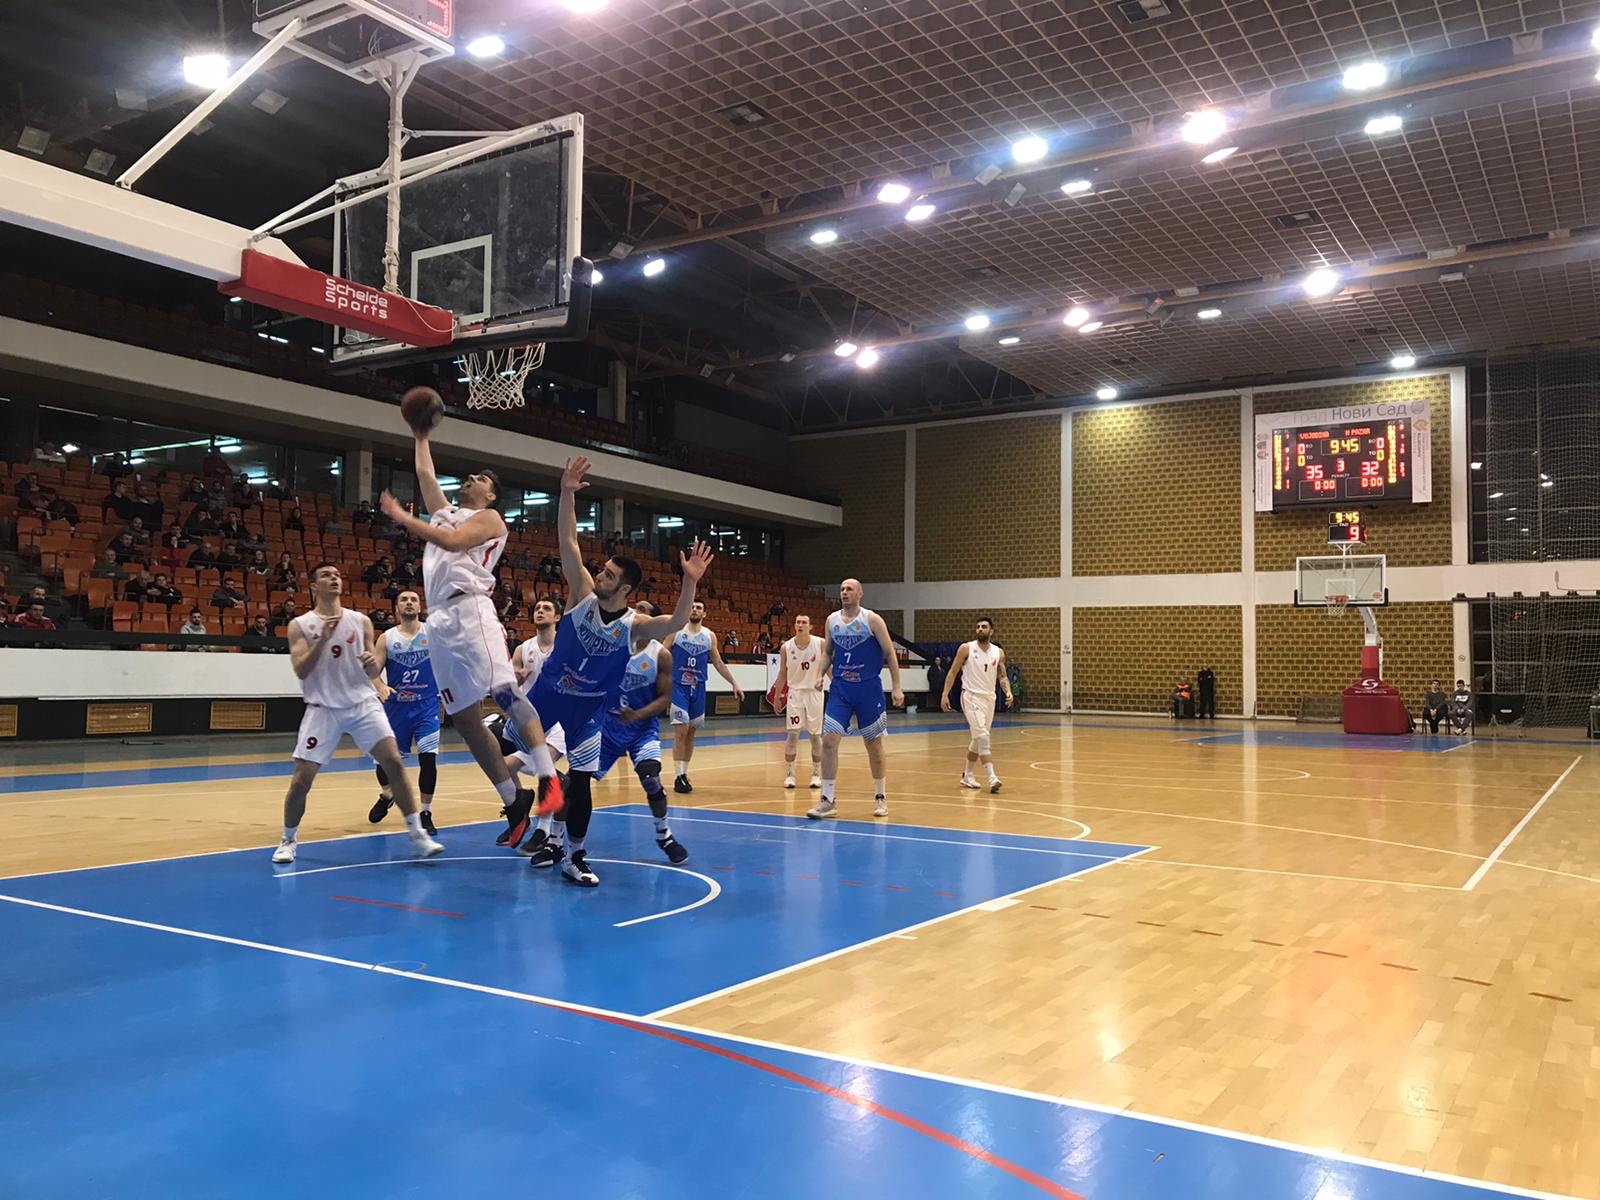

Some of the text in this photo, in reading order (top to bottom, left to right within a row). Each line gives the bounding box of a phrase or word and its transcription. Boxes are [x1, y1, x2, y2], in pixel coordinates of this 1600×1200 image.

[326, 278, 388, 308] Schelde
[325, 290, 388, 320] Sports
[1332, 407, 1371, 421] Нови
[1376, 403, 1408, 417] Сад
[1297, 443, 1306, 455] 0
[1330, 438, 1360, 454] 9:45
[1376, 437, 1385, 449] 0
[1297, 454, 1306, 467] 0
[1376, 449, 1385, 461] 0
[1306, 464, 1324, 480] 35
[1337, 460, 1345, 472] 3
[1361, 460, 1380, 476] 32
[1335, 511, 1360, 524] 9:45
[1349, 525, 1360, 541] 9
[331, 645, 342, 659] 9
[844, 652, 852, 664] 7
[578, 657, 589, 672] 1
[687, 656, 697, 668] 10
[800, 661, 810, 671] 10
[983, 663, 989, 673] 1
[402, 669, 420, 683] 27
[619, 693, 630, 708] 6
[790, 715, 800, 725] 10
[306, 736, 318, 750] 9
